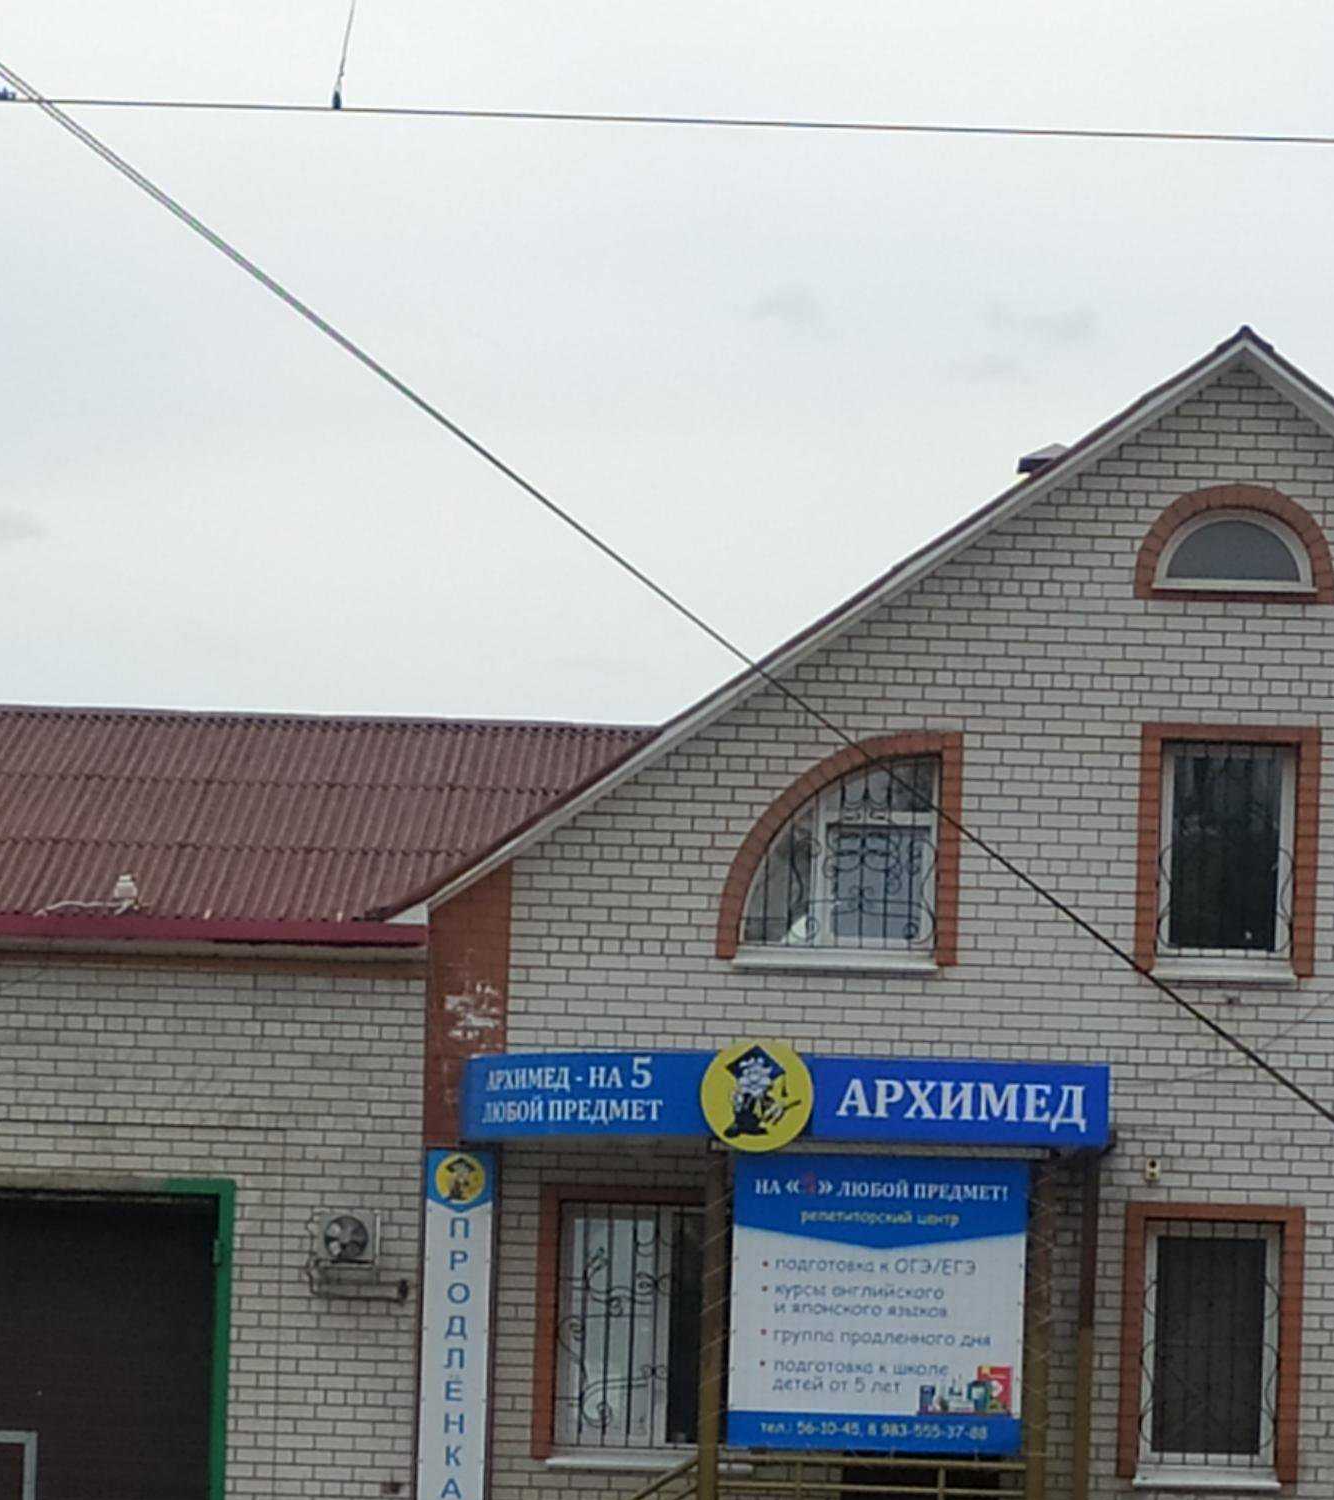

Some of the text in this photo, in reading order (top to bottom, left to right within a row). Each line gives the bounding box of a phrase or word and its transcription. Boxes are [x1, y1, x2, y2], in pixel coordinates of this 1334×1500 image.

[486, 1065, 571, 1092] АРХИМЕД
[589, 1065, 623, 1089] НА
[631, 1056, 653, 1089] 5
[482, 1094, 664, 1125] ЛЮБОЙ ПРЕДМЕТ
[835, 1078, 1088, 1133] АРХИМЕД
[755, 1179, 782, 1195] НА
[836, 1178, 909, 1199] ЛЮБОЙ
[913, 1181, 1008, 1202] ПРЕДМЕТ!
[800, 1209, 961, 1228] репетиторский центр
[775, 1257, 977, 1276] подготовка к ОГЭ/ЕГЭ
[774, 1283, 945, 1300] курсы английского
[774, 1302, 948, 1319] и японского языков
[773, 1328, 834, 1346] группа
[960, 1334, 992, 1348] дня
[440, 1217, 471, 1500] ПРОДЛЁНКА
[773, 1359, 950, 1377] подготовка к школе
[772, 1375, 902, 1394] детей от 5 лет
